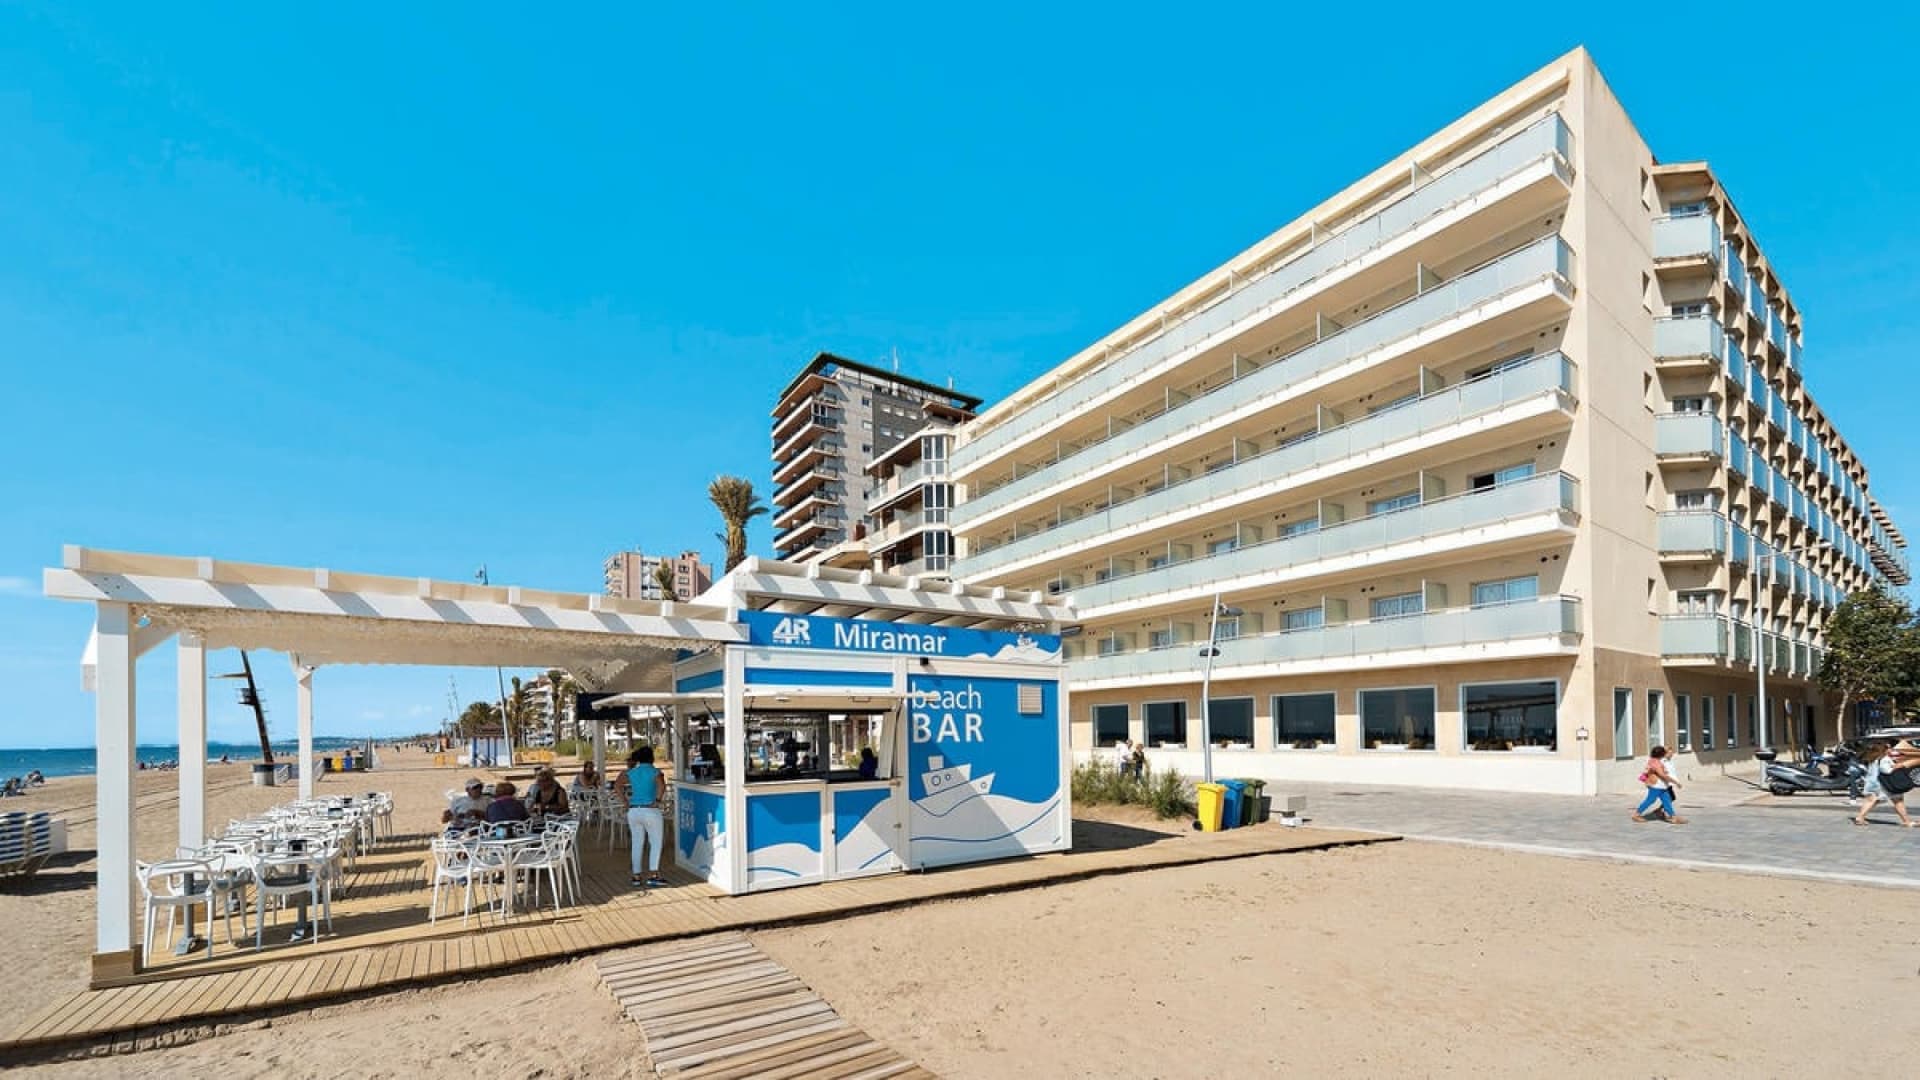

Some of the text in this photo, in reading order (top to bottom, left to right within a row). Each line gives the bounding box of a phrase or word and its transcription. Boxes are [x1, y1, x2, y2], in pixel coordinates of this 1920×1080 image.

[834, 622, 947, 653] Miramar
[911, 680, 982, 709] beach
[912, 712, 984, 743] BAR
